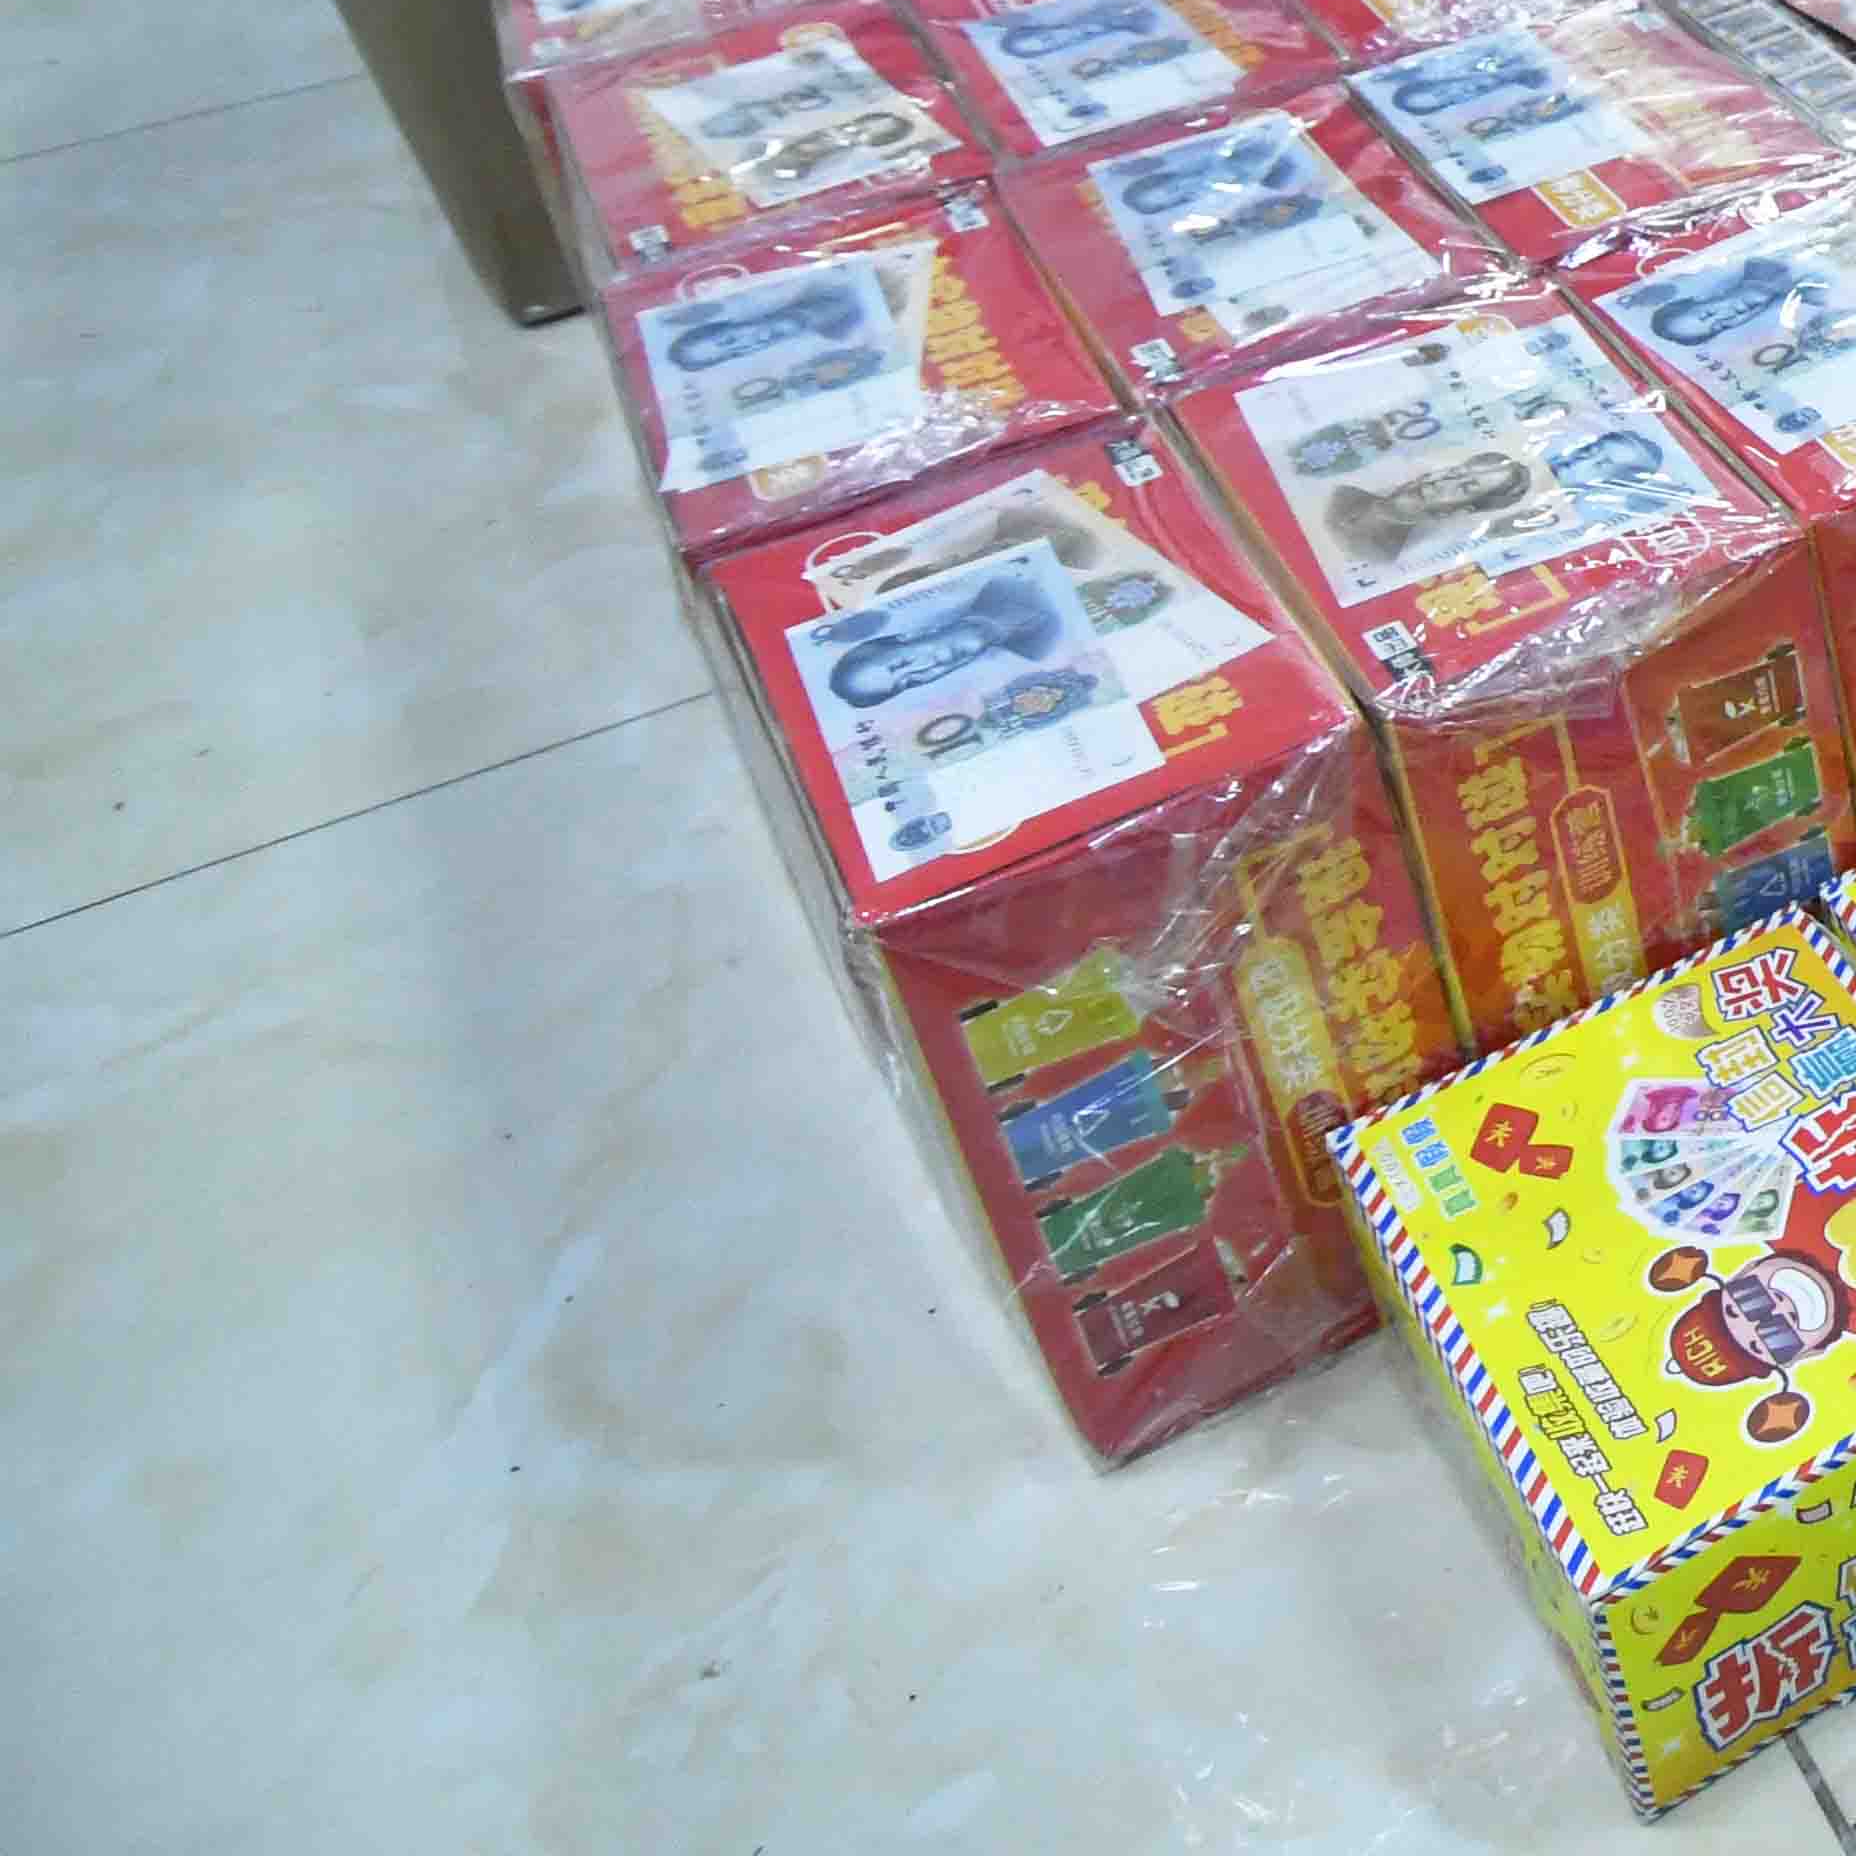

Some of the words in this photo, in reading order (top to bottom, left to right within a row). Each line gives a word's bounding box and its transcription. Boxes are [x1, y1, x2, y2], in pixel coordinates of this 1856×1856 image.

[1687, 1022, 1812, 1135] 信封
[1676, 1323, 1729, 1380] RICH
[1688, 1582, 1841, 1766] 拆
